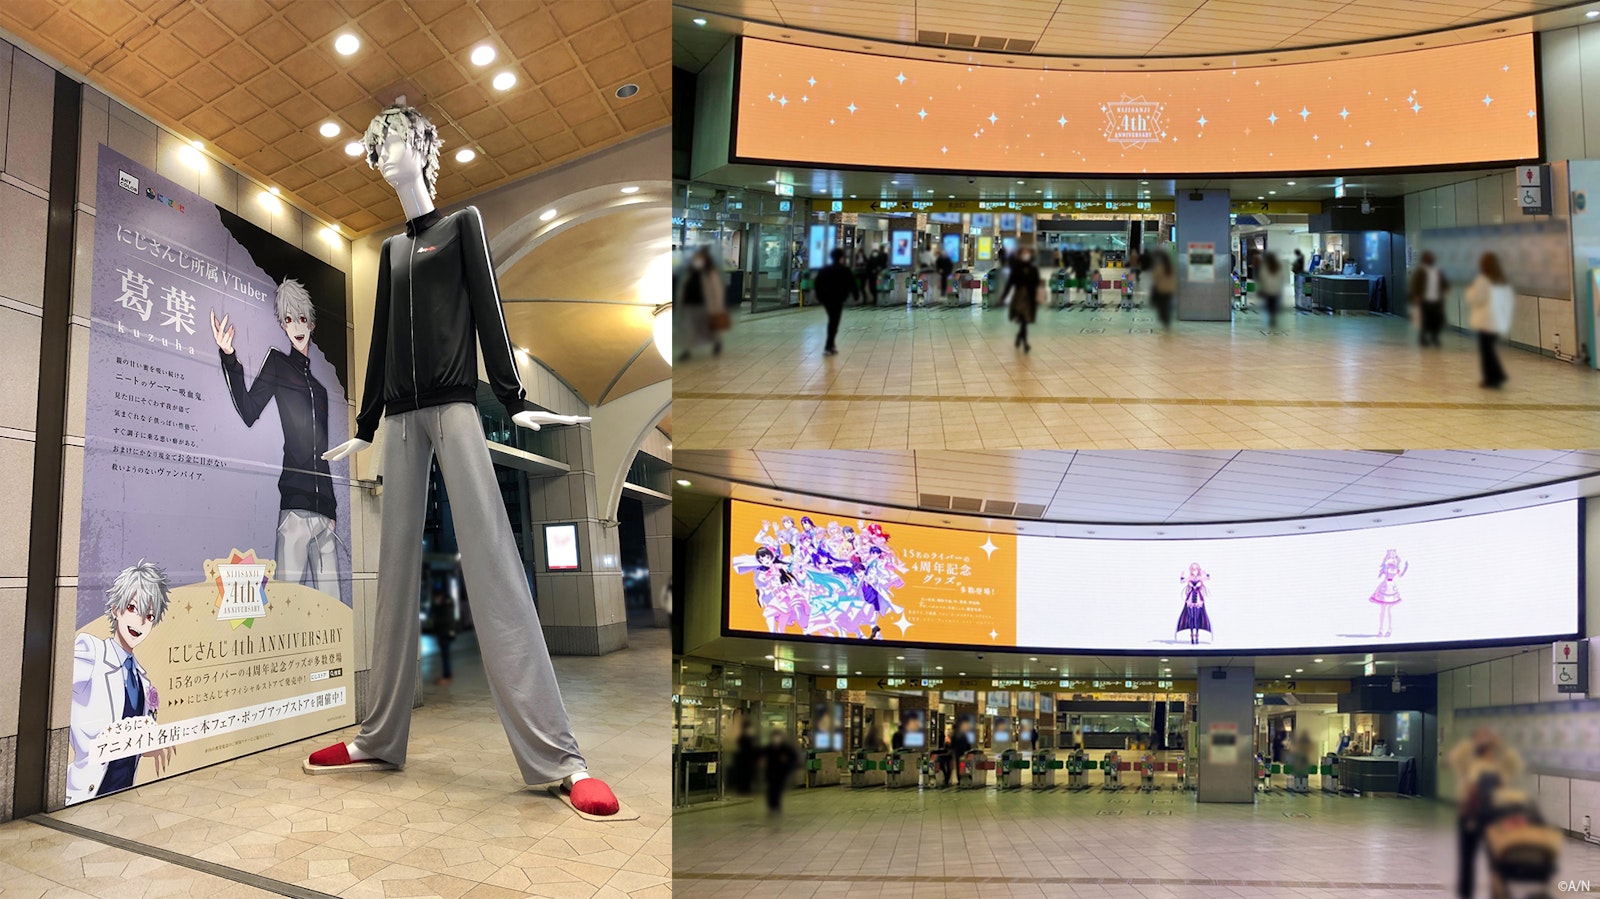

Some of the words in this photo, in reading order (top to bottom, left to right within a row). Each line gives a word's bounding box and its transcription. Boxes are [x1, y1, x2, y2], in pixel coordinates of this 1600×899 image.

[1121, 114, 1147, 131] 4th
[116, 224, 219, 284] にじさんじ所属
[221, 270, 268, 303] VTuber
[114, 268, 197, 336] 葛葉
[912, 561, 972, 576] 4周年記念
[230, 580, 255, 604] 4th
[168, 640, 229, 665] にじさんじ
[231, 635, 254, 657] 4th
[258, 628, 343, 653] ANNIVERSARY
[168, 652, 343, 690] 15名のライバーの4周年記念グッズが多数登場
[115, 718, 143, 735] さらに
